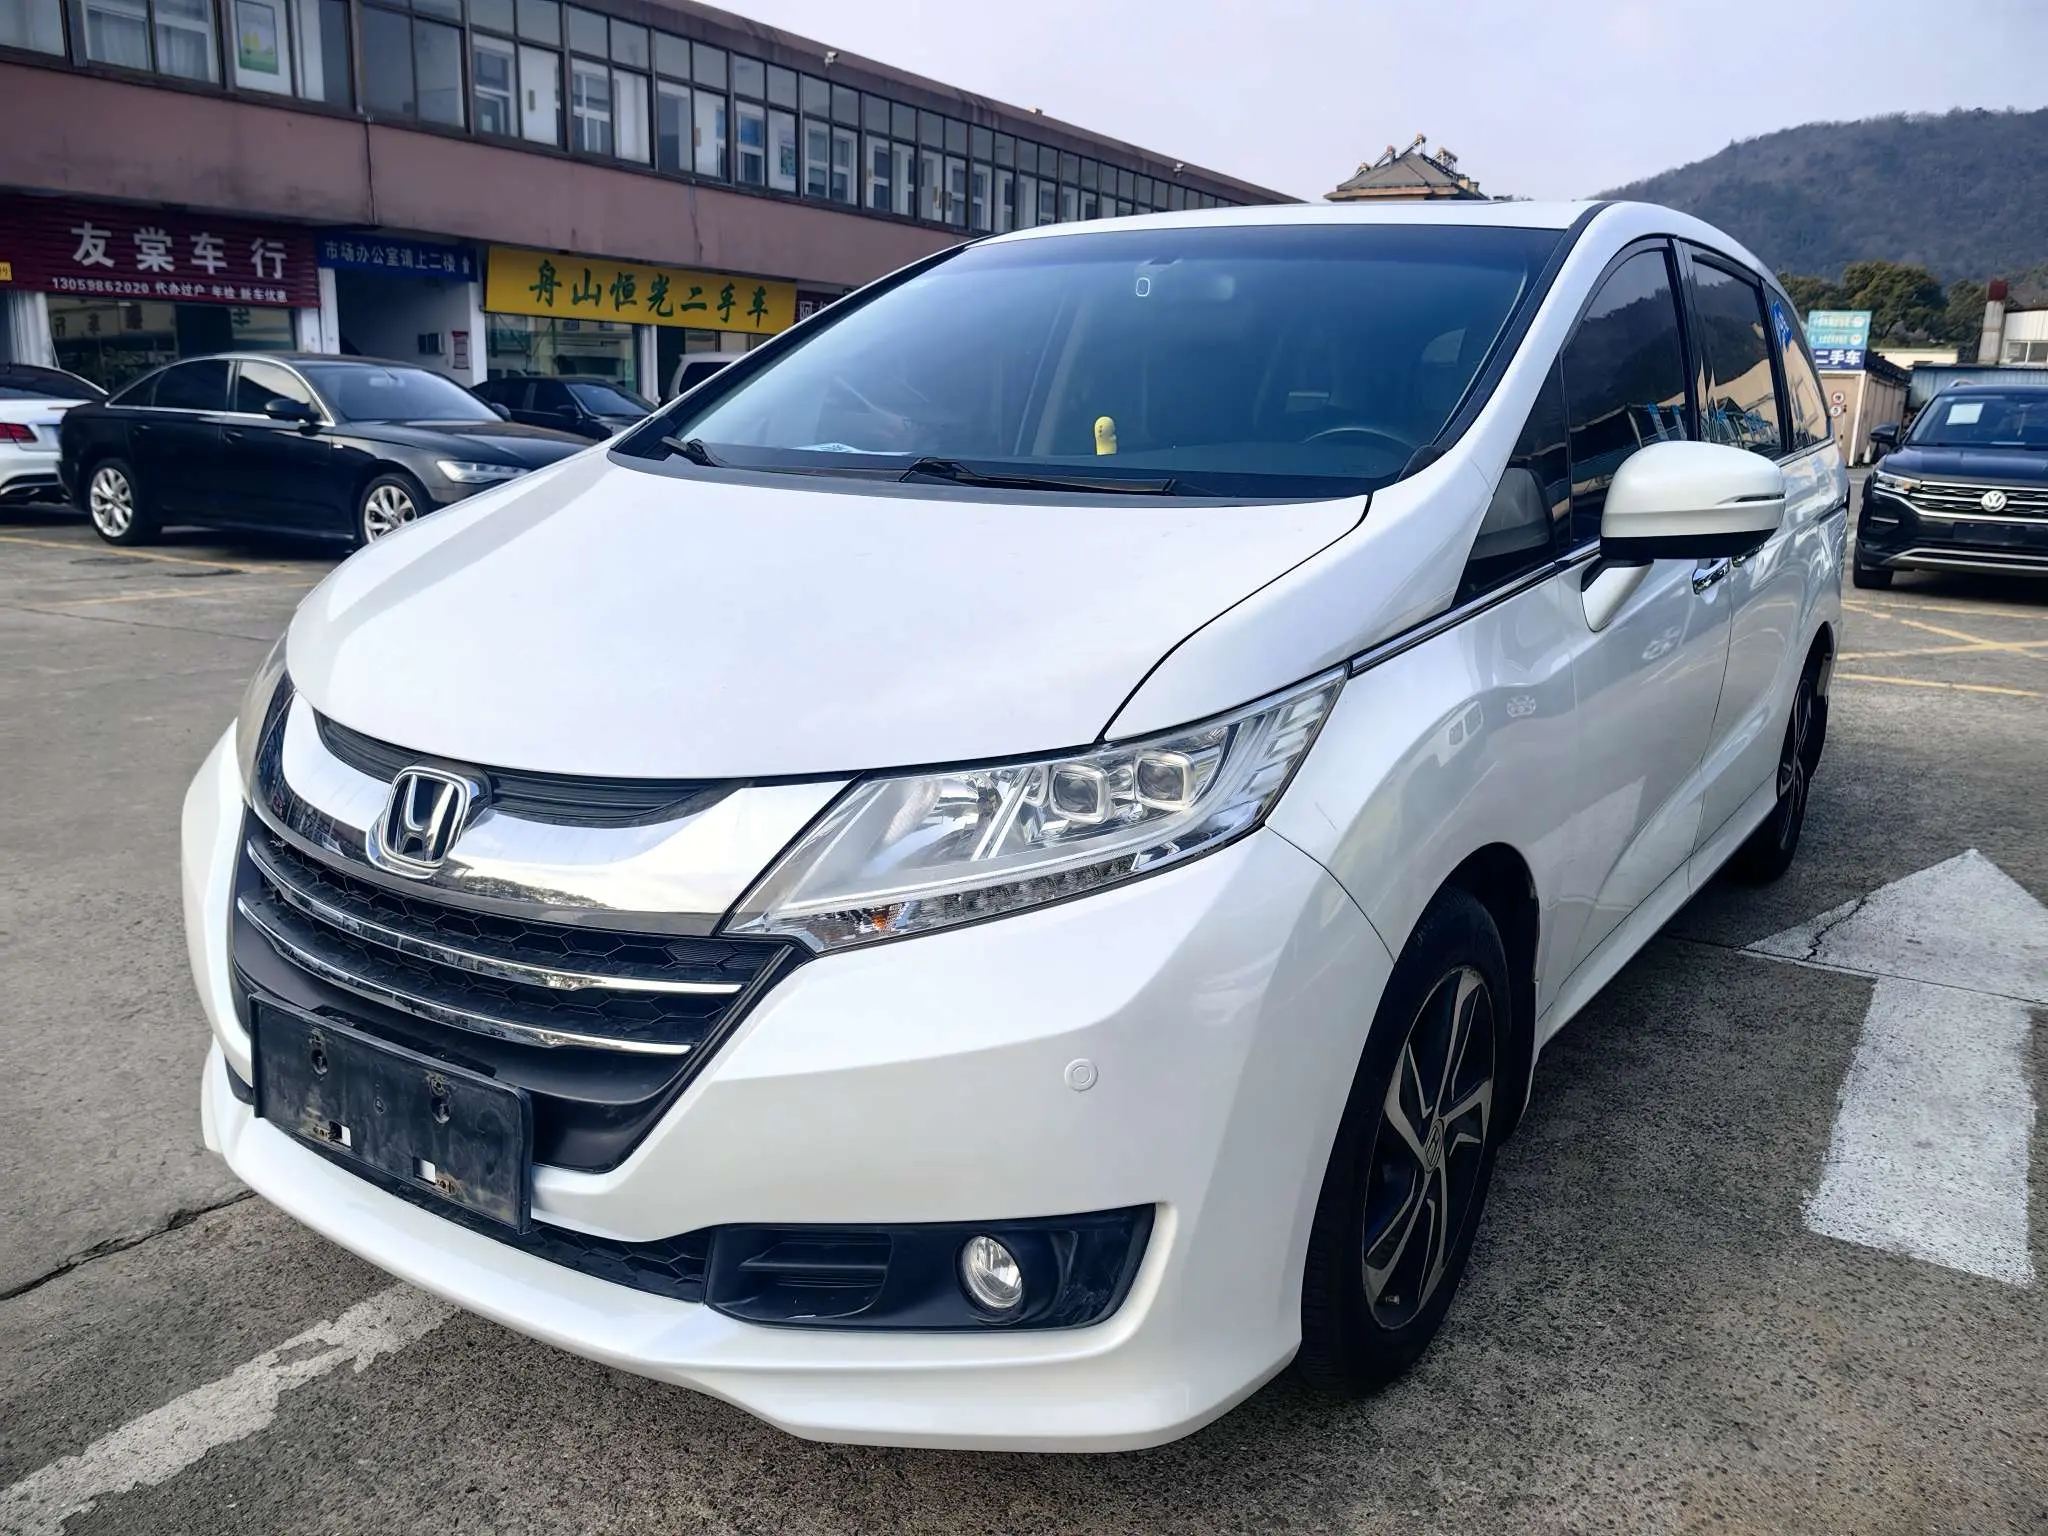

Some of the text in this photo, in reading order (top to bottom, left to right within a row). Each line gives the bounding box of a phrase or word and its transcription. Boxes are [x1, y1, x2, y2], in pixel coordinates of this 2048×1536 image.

[70, 220, 287, 280] 友棠车行
[325, 240, 456, 273] 市场办公室请上二楼
[529, 258, 769, 329] 舟山恒光二手车
[1815, 350, 1861, 366] 二手车
